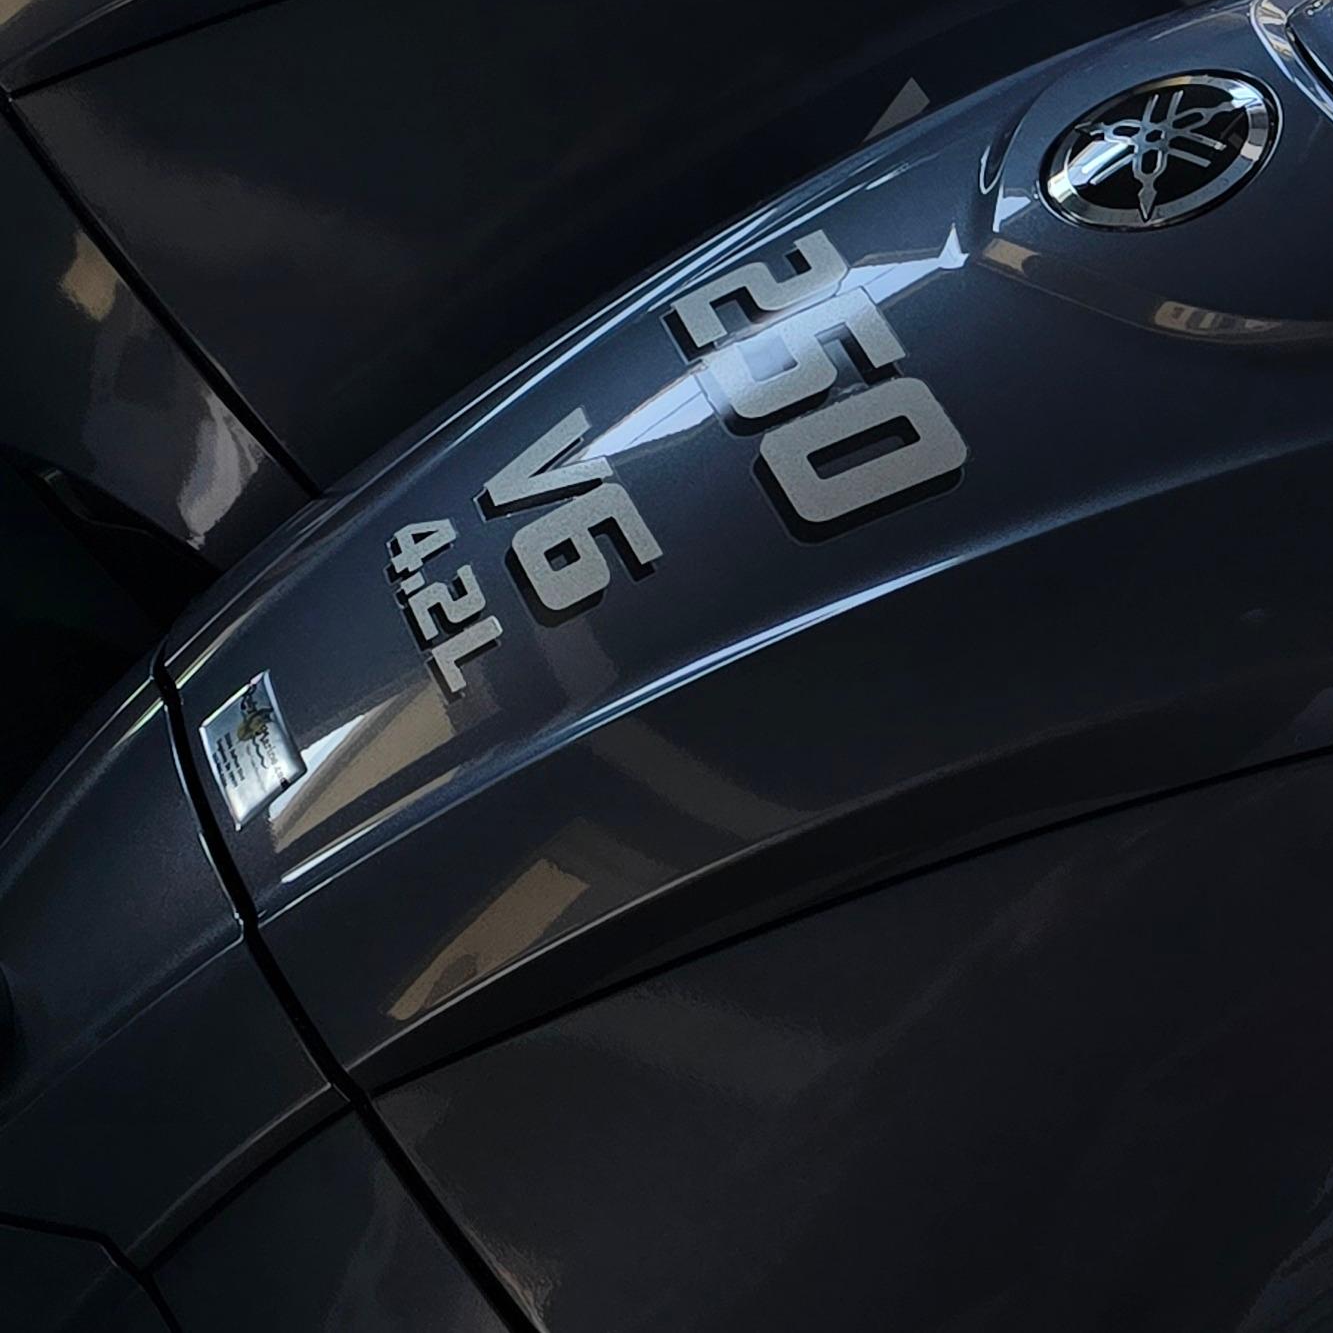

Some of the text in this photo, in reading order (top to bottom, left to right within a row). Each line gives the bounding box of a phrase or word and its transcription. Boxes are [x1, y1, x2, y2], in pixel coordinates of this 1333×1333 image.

[668, 230, 968, 526] 250
[388, 518, 503, 696] 4.2L
[480, 407, 664, 614] V6
